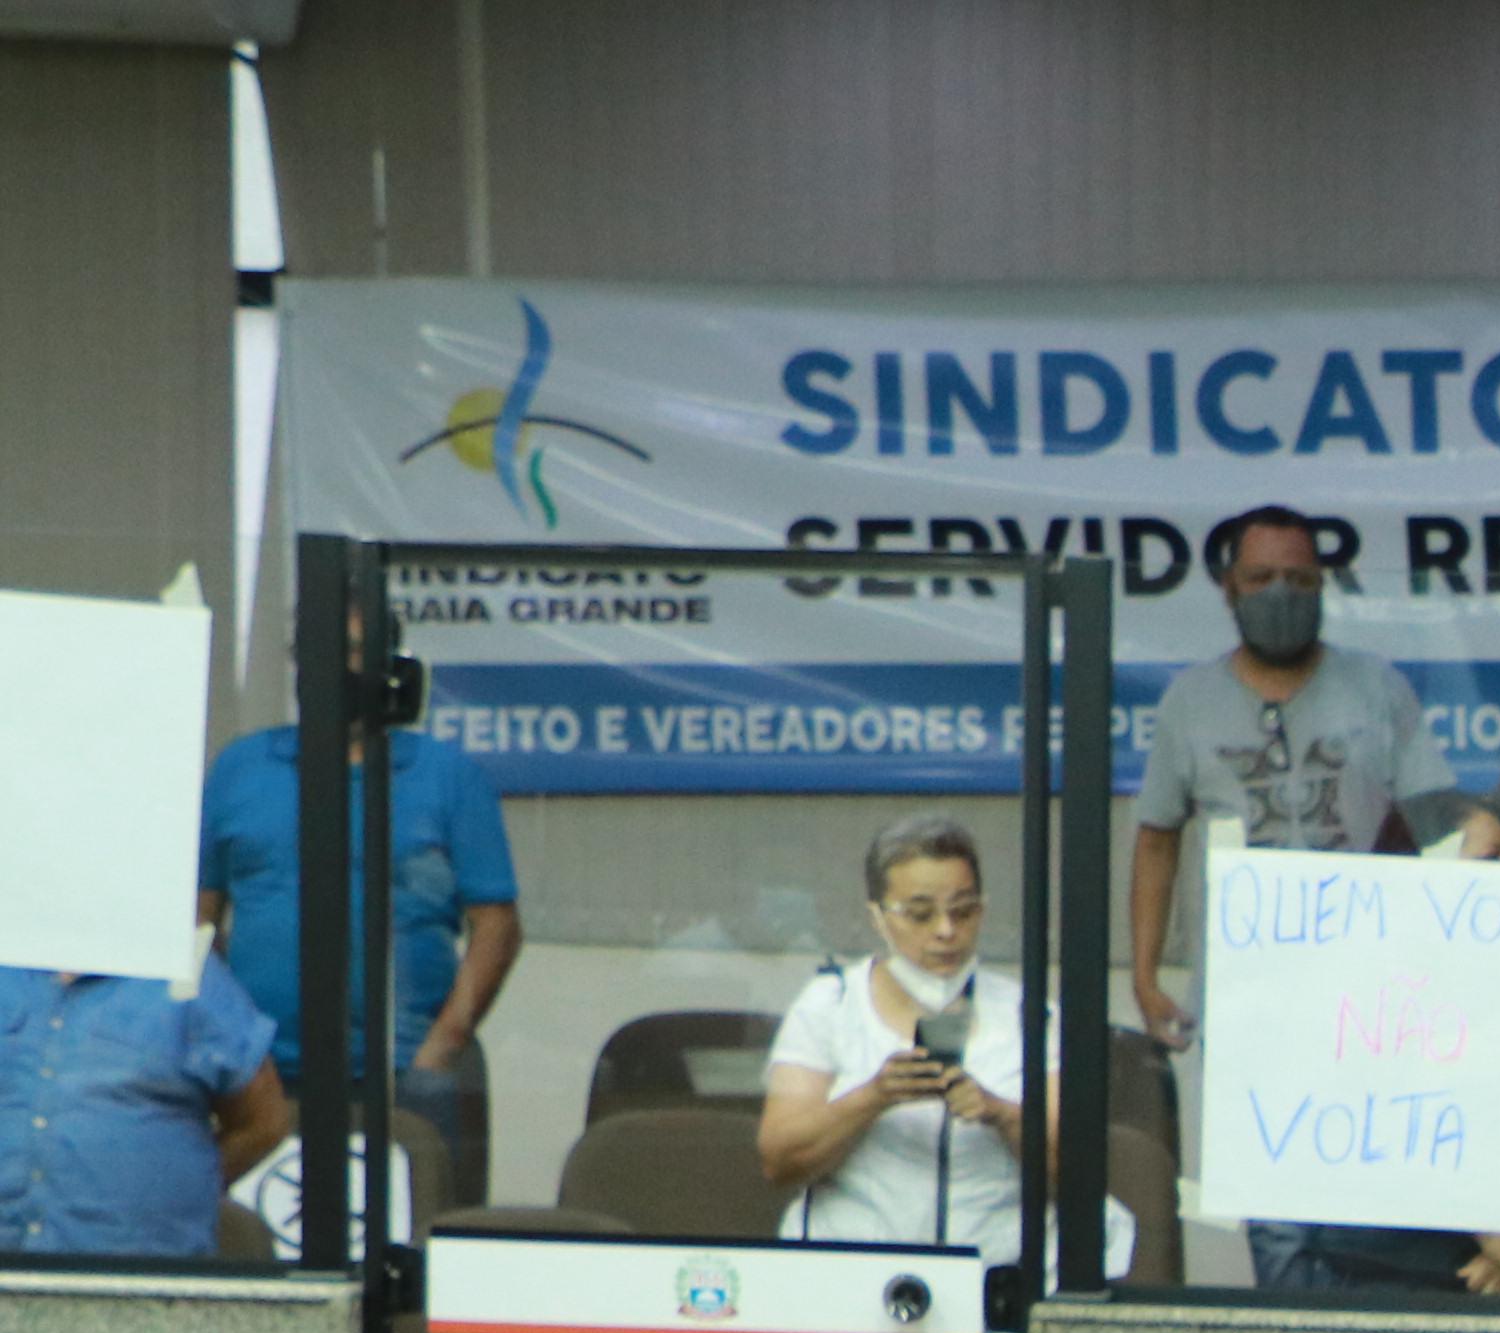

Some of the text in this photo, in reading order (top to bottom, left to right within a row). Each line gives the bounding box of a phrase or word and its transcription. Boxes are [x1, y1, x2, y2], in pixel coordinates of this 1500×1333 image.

[390, 597, 712, 624] RAIA GRANDE
[430, 705, 582, 753] FEITO
[594, 706, 629, 753] E
[641, 705, 988, 754] VEREADORES
[1218, 863, 1386, 951] QUEM
[1333, 972, 1470, 1065] NÃO
[1247, 1087, 1466, 1171] VOLTA
